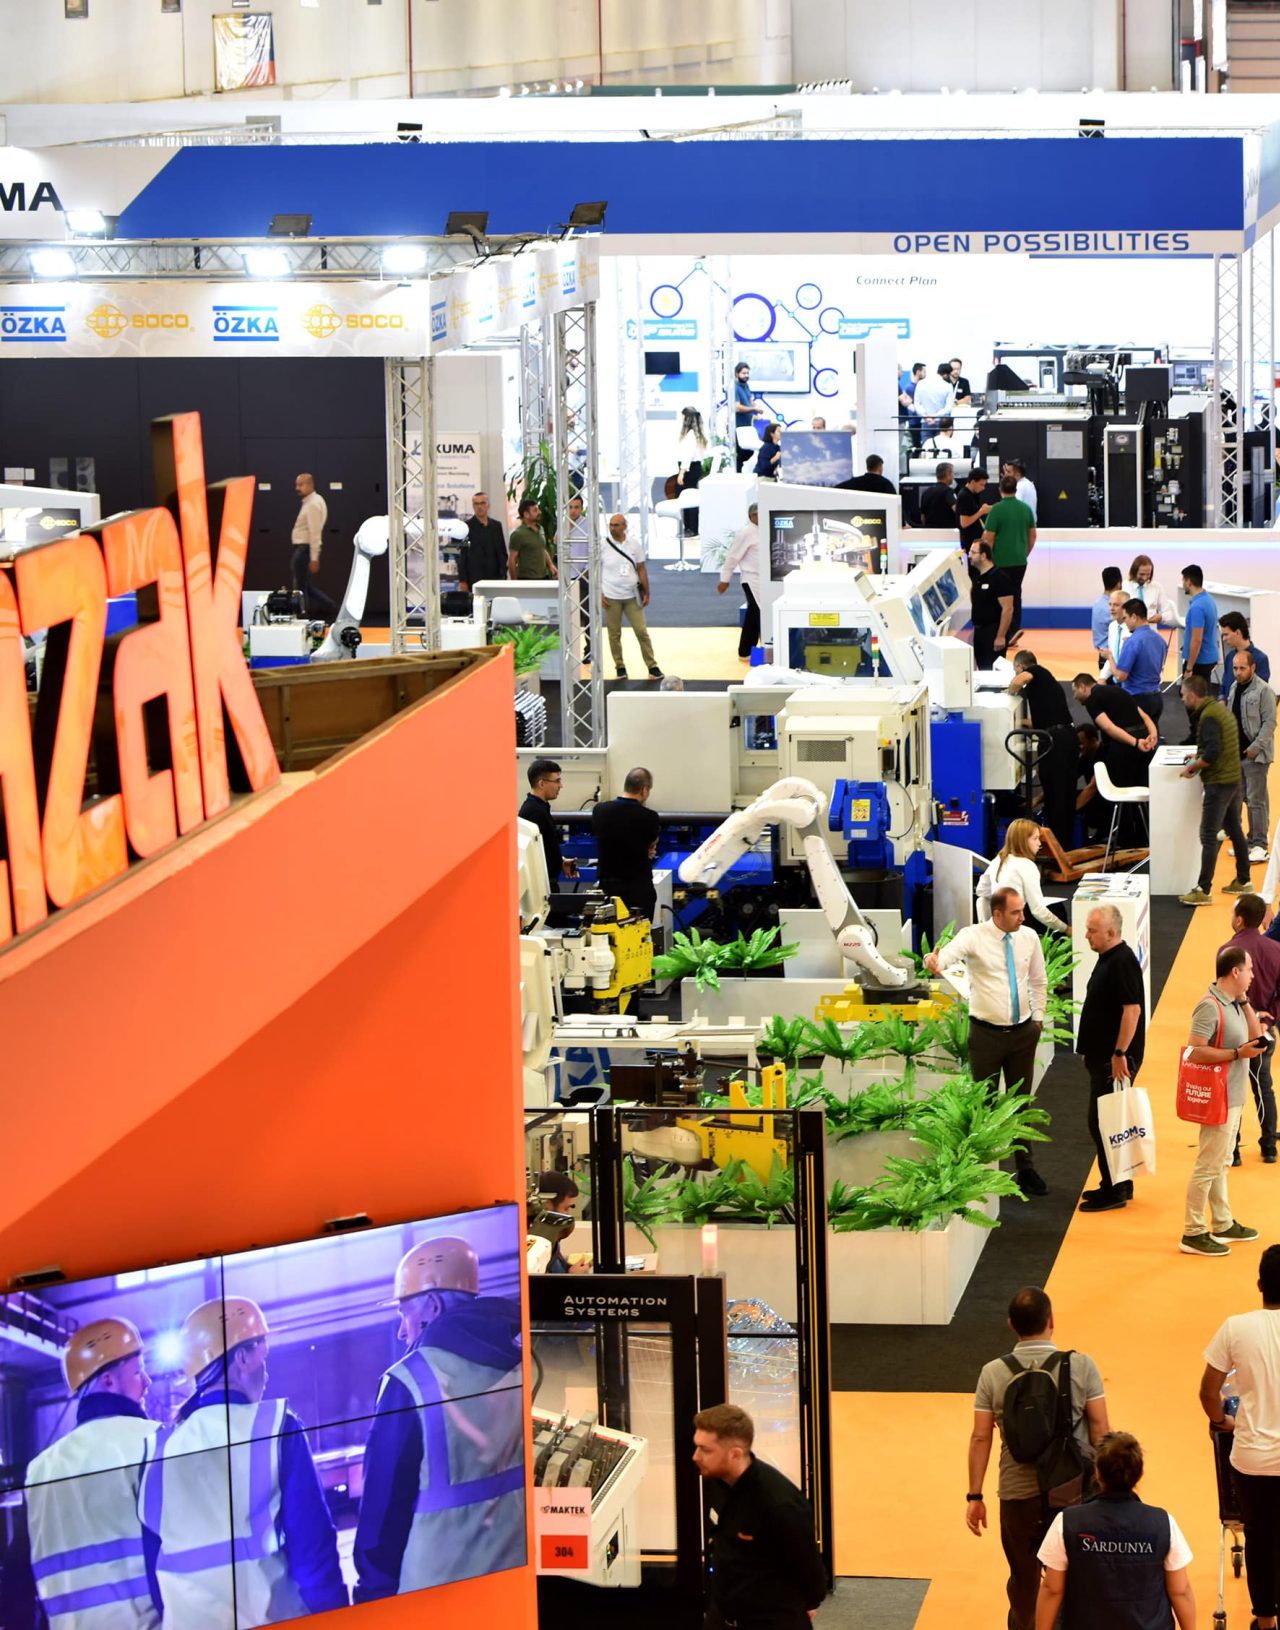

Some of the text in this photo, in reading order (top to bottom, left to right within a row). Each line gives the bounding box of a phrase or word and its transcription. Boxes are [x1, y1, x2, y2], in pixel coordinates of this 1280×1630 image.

[893, 232, 1190, 253] OPEN POSSIBILITIES
[856, 275, 938, 286] Connect Plan
[1, 313, 66, 334] ÖZKA
[132, 314, 189, 328] SOCO
[214, 312, 279, 333] ÖZKA
[345, 314, 403, 328] SOCO
[563, 1295, 668, 1306] AUTOMATION
[564, 1306, 640, 1317] SYSTEMS
[550, 1506, 585, 1515] MAKTEK
[554, 1546, 574, 1557] 304
[1082, 1537, 1153, 1554] SARDUNYA
